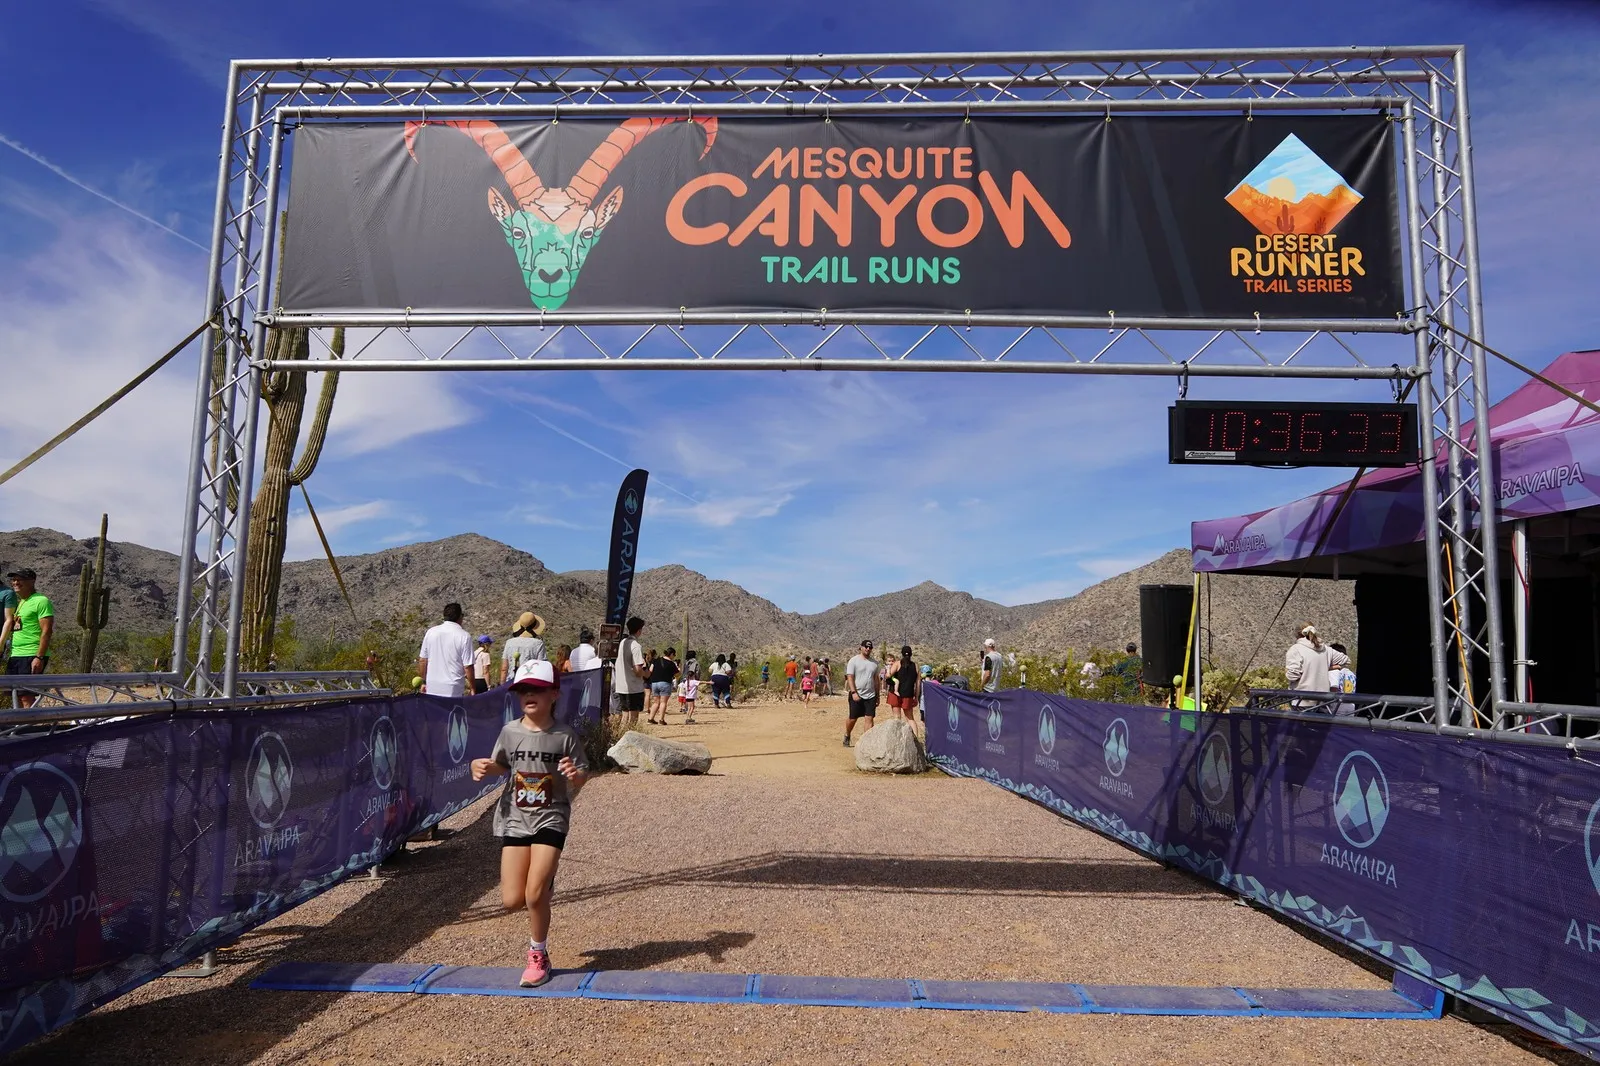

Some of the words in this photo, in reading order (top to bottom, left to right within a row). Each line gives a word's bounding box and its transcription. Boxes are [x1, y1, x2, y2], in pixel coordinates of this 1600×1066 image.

[752, 146, 973, 180] MESQUITE
[665, 170, 1072, 248] CANYON
[1255, 234, 1337, 252] DESERT
[761, 256, 858, 284] TRAIL
[869, 256, 961, 284] RUNS
[1230, 247, 1366, 277] RUNNER
[1244, 279, 1292, 293] TRAIL
[1297, 279, 1353, 293] SERIES
[1223, 534, 1267, 555] ARAVAIPA
[517, 789, 547, 804] 984
[1099, 775, 1134, 799] ARAVAIPA
[234, 825, 300, 867] ARAVAIPA
[1320, 843, 1398, 889] ARAVAIPA
[0, 890, 100, 949] AVAIPA
